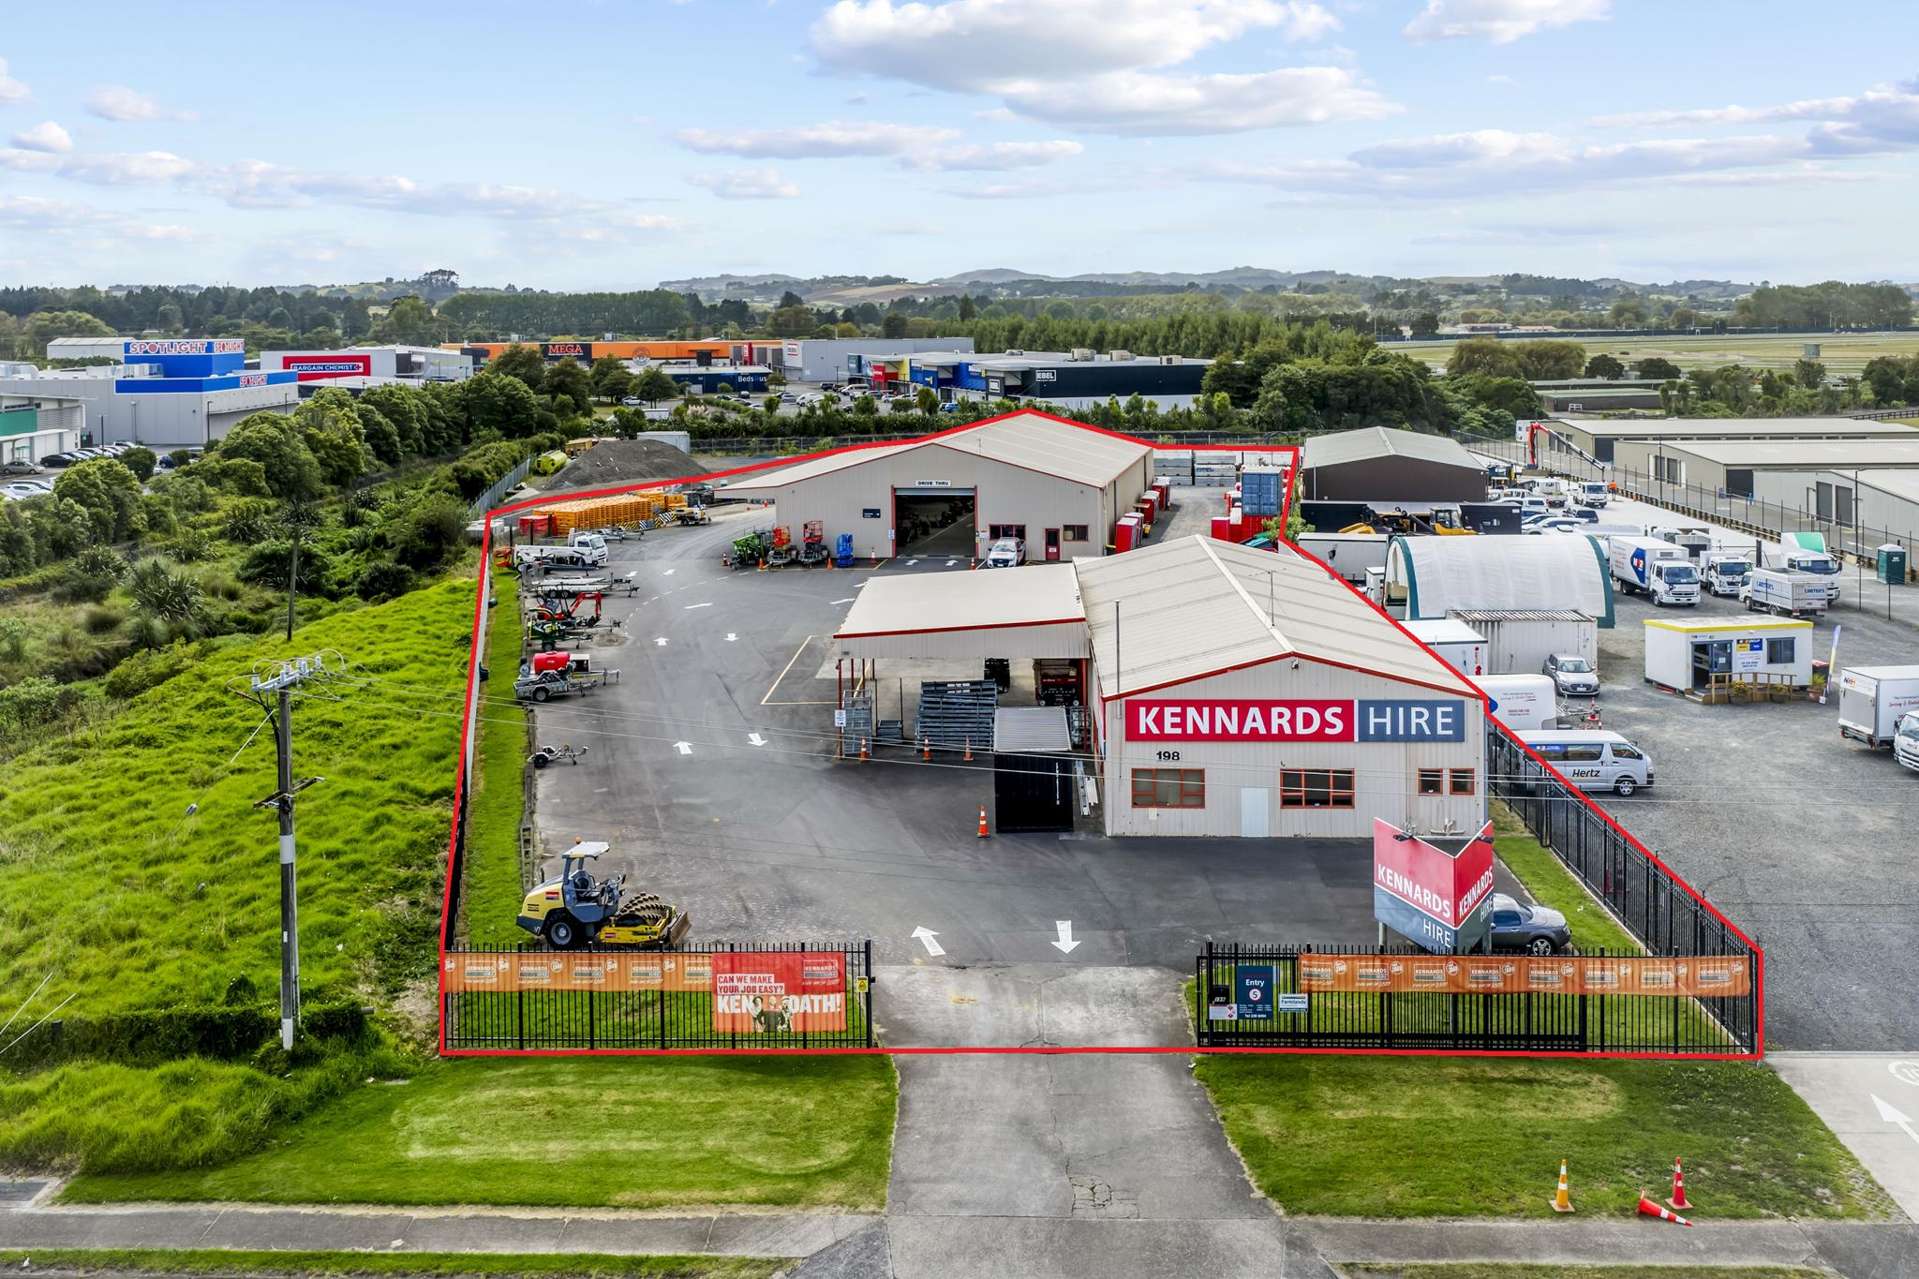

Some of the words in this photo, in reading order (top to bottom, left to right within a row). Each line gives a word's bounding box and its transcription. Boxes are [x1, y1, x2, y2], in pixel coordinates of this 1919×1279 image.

[130, 342, 207, 353] SPOTLIGHT
[548, 345, 583, 353] MEGA
[1138, 706, 1344, 736] KENNARDS
[1369, 706, 1454, 735] HIRE
[1156, 751, 1181, 761] 198
[1572, 768, 1601, 778] Hertz
[1377, 864, 1451, 919] KENNARDS
[1459, 866, 1494, 919] KENNARDS
[1480, 896, 1494, 922] HIRE
[1423, 918, 1451, 948] HIRE
[718, 976, 735, 984] CAN
[736, 976, 748, 984] WE
[1245, 979, 1265, 987] Entry
[718, 985, 740, 993] YOUR
[741, 985, 757, 993] JOB
[758, 985, 784, 993] EASY?
[717, 995, 755, 1013] KEN
[790, 994, 841, 1013] OATH!
